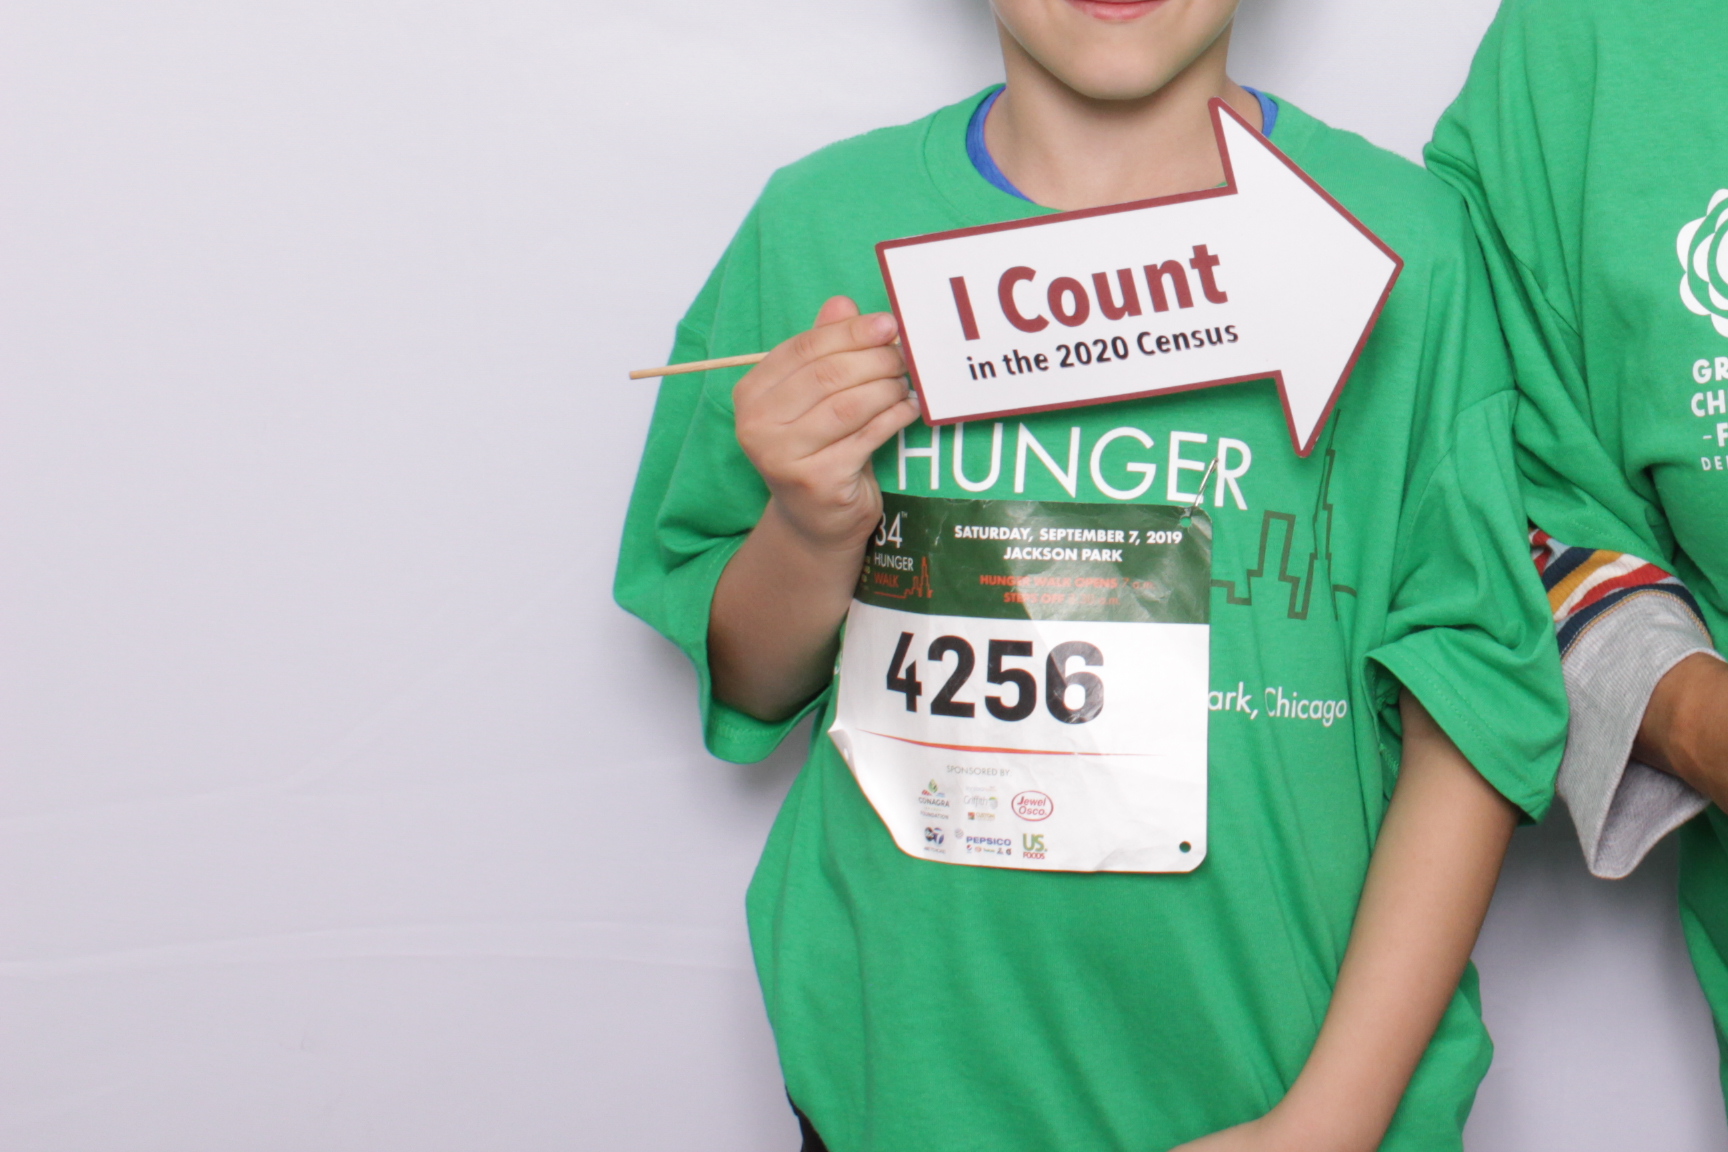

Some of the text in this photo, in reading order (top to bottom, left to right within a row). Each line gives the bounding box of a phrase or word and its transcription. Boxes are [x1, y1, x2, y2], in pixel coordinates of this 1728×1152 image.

[949, 244, 1228, 341] I Count
[966, 324, 1239, 380] in the 2020 Census
[897, 422, 1252, 511] HUNGER
[954, 525, 1183, 546] SATURDAY, SEPTEMBER 7, 2019
[874, 552, 914, 571] HUNGER
[1003, 547, 1123, 562] JACKSON PARK
[873, 573, 899, 587] WALK
[980, 574, 1030, 587] HUNGER
[1033, 576, 1072, 588] WALK
[1074, 577, 1118, 589] OPENS
[1003, 592, 1039, 603] STEPS
[1042, 593, 1065, 604] OFF
[886, 631, 1104, 724] 4256
[1208, 681, 1347, 727] ark, Chicago
[946, 765, 997, 776] SPONSORED
[918, 797, 950, 807] CONAGRA
[1017, 796, 1046, 806] Jewel
[966, 836, 1012, 846] PEPSICO
[1023, 852, 1045, 860] FOODS
